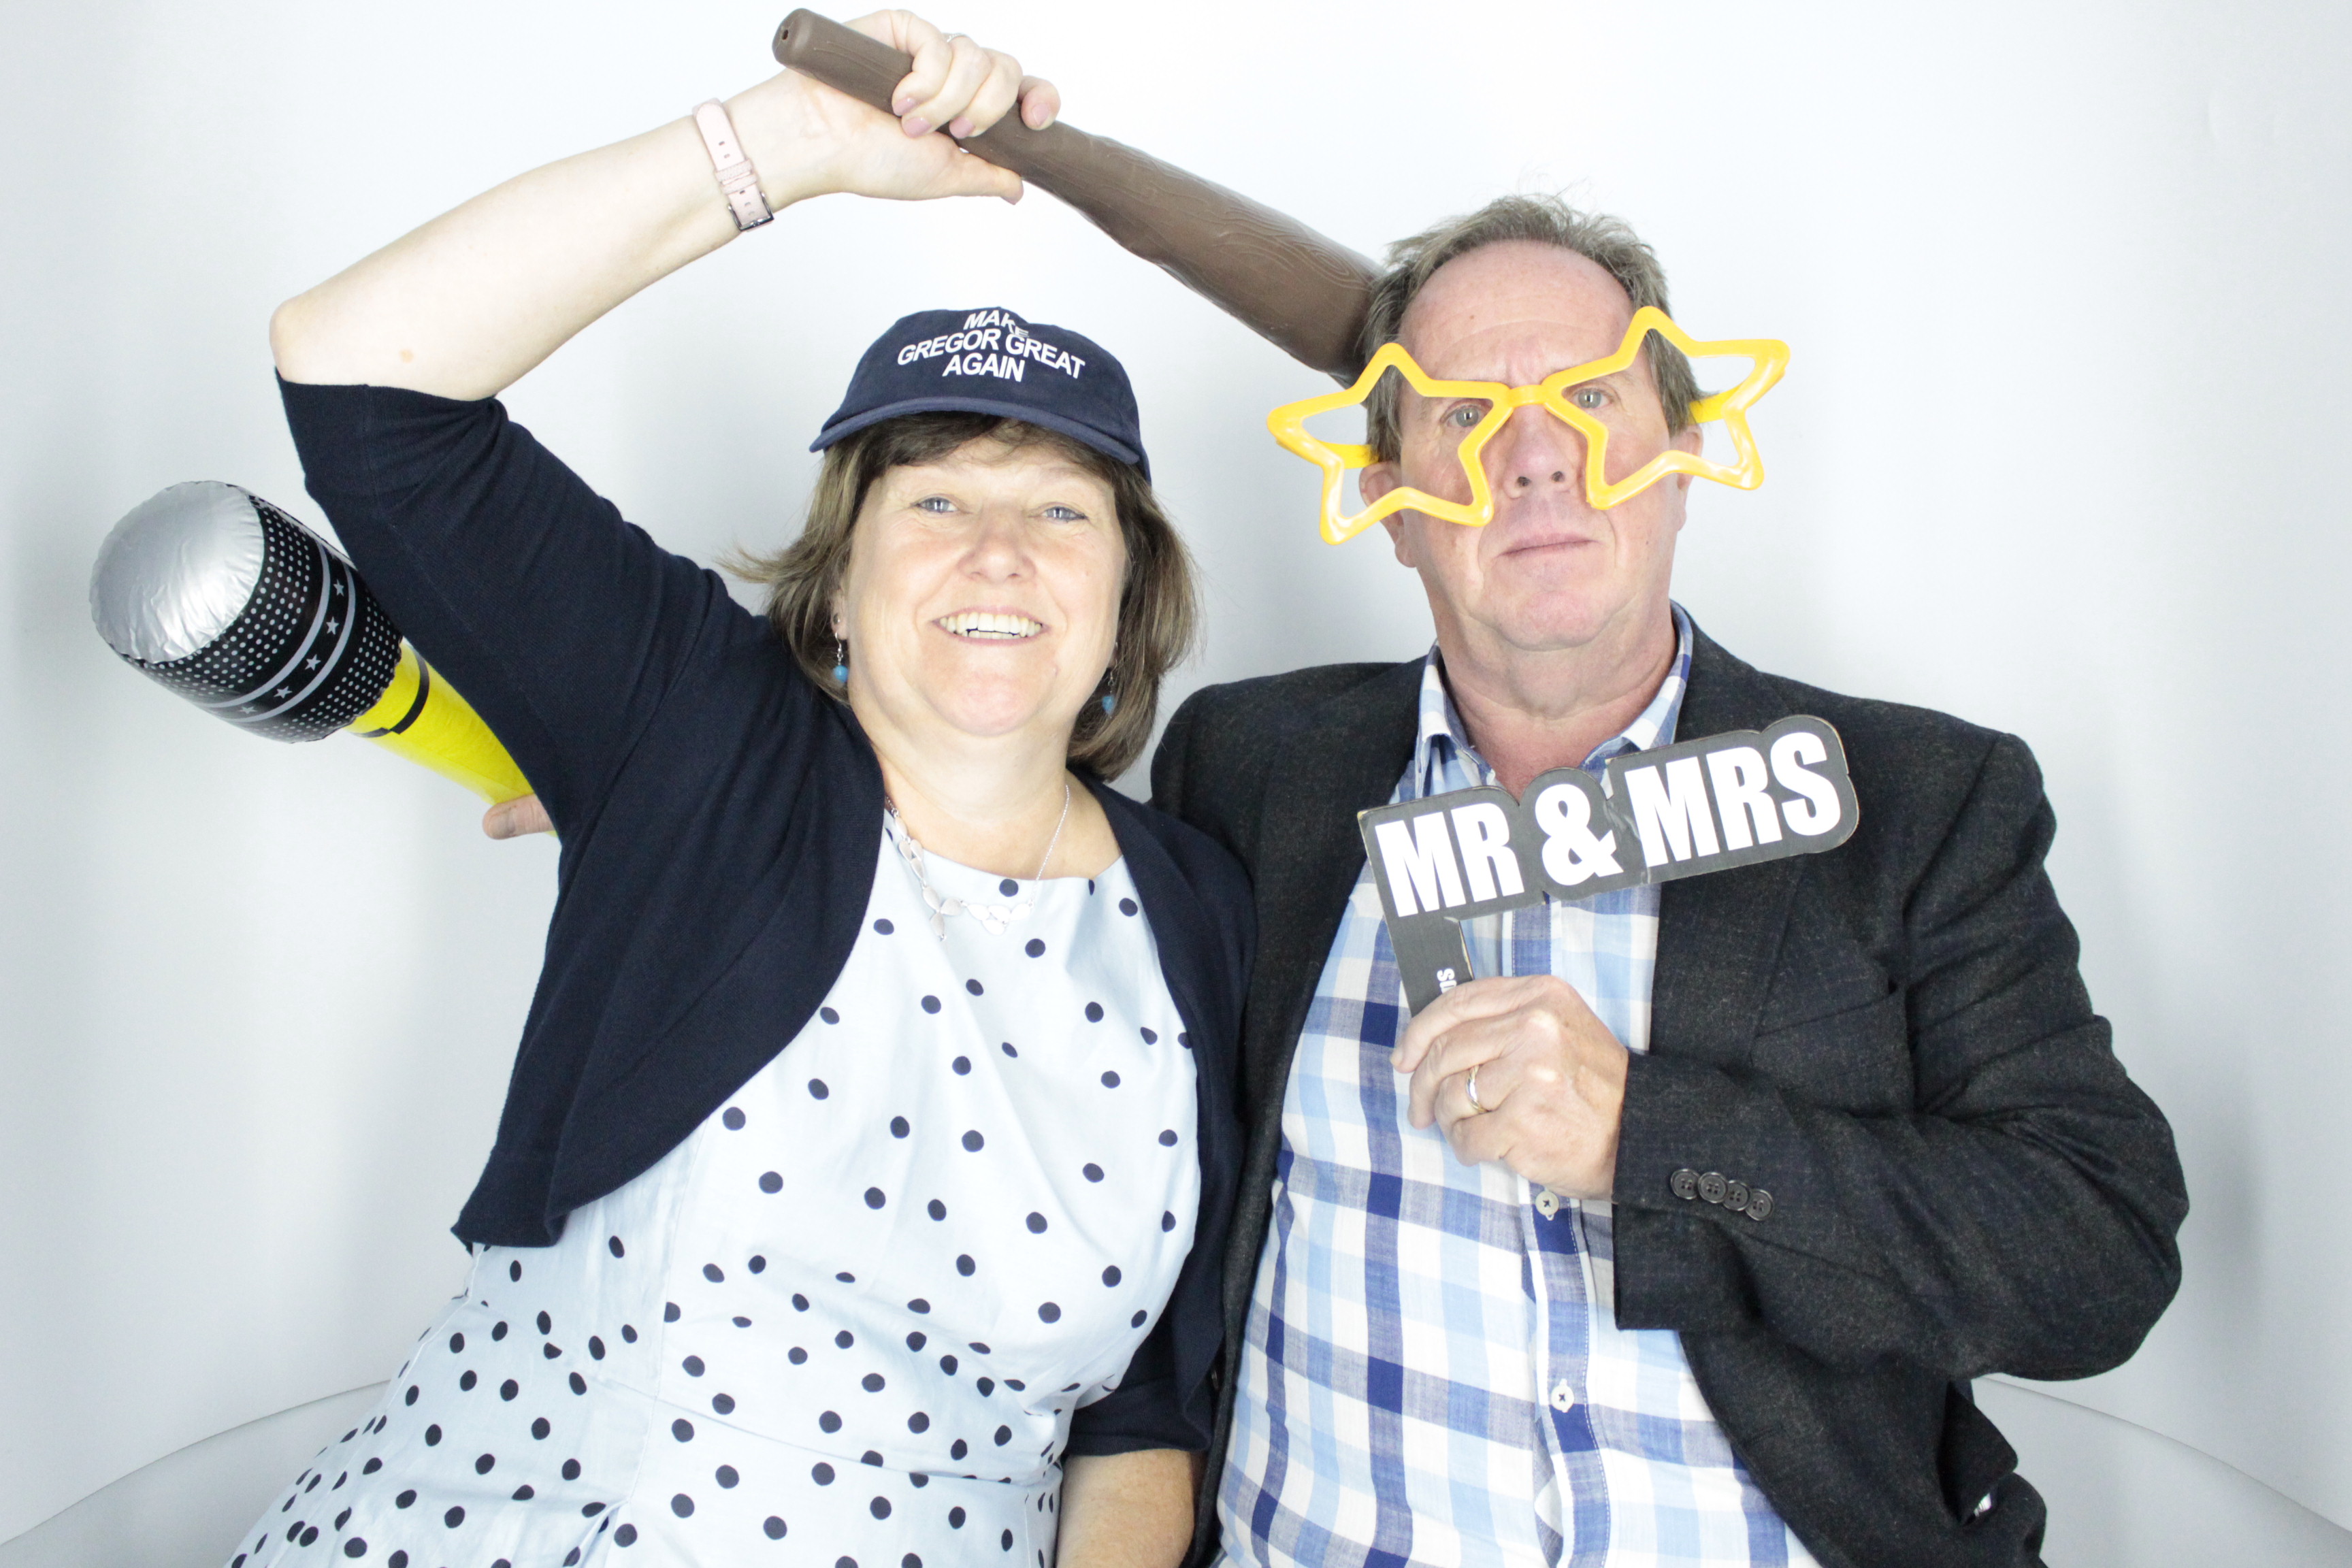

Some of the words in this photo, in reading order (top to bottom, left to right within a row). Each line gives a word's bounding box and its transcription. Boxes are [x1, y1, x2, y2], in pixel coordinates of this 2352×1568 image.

[963, 310, 1029, 338] MAKE
[897, 328, 1002, 365] GREGOR
[1005, 333, 1085, 379] GREAT
[942, 352, 1026, 382] AGAIN
[1375, 802, 1524, 917] MR
[1535, 784, 1624, 885] &
[1624, 732, 1842, 868] MRS
